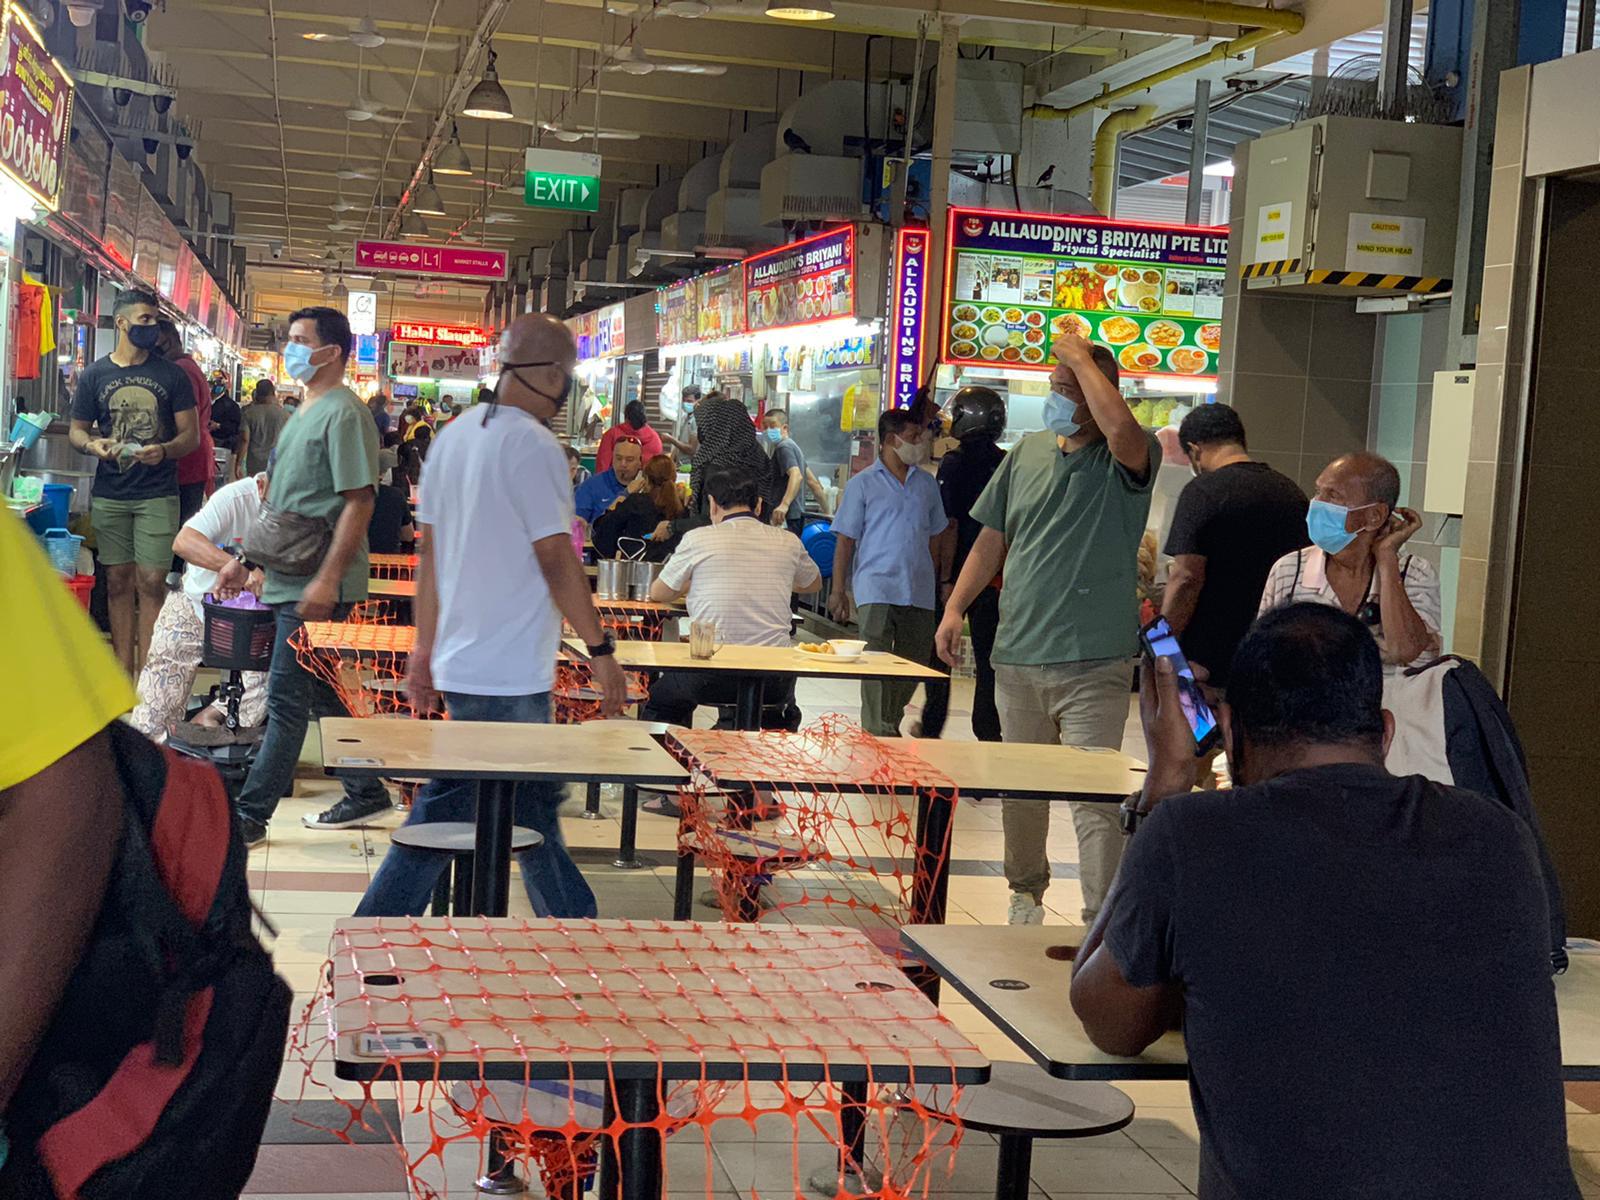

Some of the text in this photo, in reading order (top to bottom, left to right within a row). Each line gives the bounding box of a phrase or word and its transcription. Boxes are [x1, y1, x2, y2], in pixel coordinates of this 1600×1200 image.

[534, 176, 579, 203] EXIT
[1371, 222, 1400, 232] CAUTION
[988, 221, 1229, 254] ALLAUDDIN'S BRIYANI PTE LTD
[1052, 241, 1161, 260] Briyani Specialist
[1357, 244, 1375, 252] MIND
[1376, 245, 1394, 254] YOUR
[424, 252, 440, 267] L1
[754, 254, 804, 280] ALLAUDDIN'S
[806, 243, 842, 266] BRIYANI
[401, 324, 433, 340] Halal
